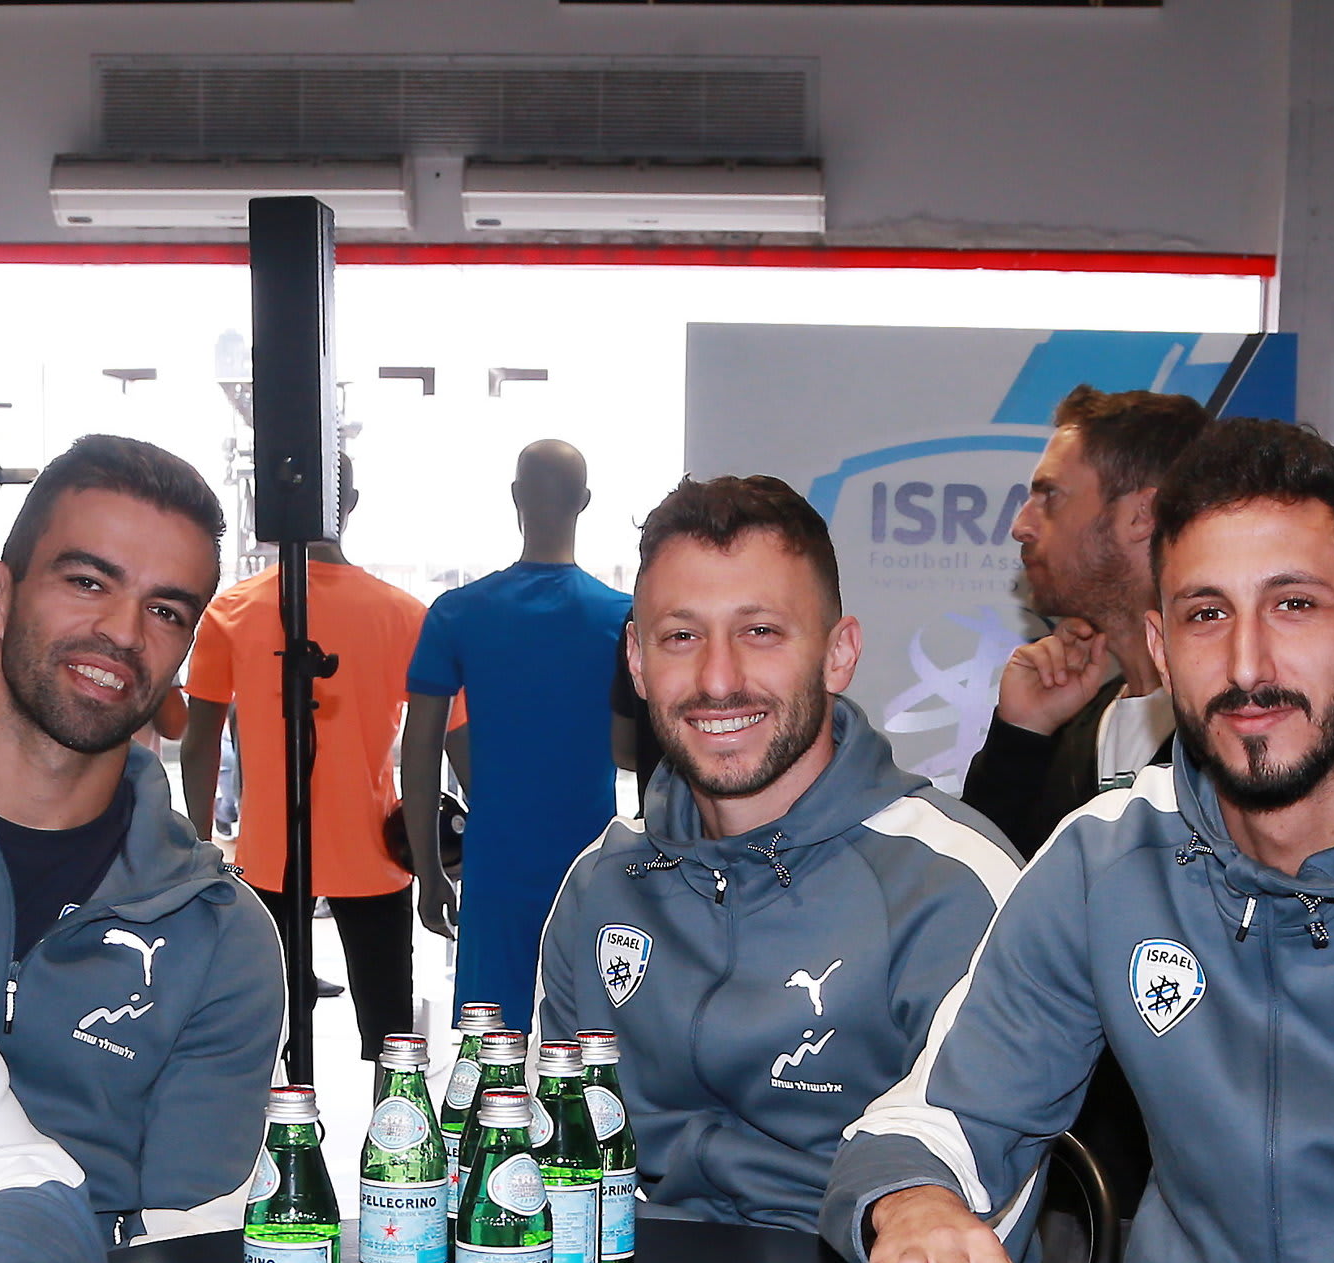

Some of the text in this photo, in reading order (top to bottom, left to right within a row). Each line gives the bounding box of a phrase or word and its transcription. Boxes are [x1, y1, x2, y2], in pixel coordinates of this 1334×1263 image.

[869, 552, 971, 569] Football
[607, 932, 640, 950] ISRAEL
[1147, 948, 1194, 971] ISRAEL
[72, 1029, 98, 1045] שחם
[771, 1078, 794, 1089] שחם
